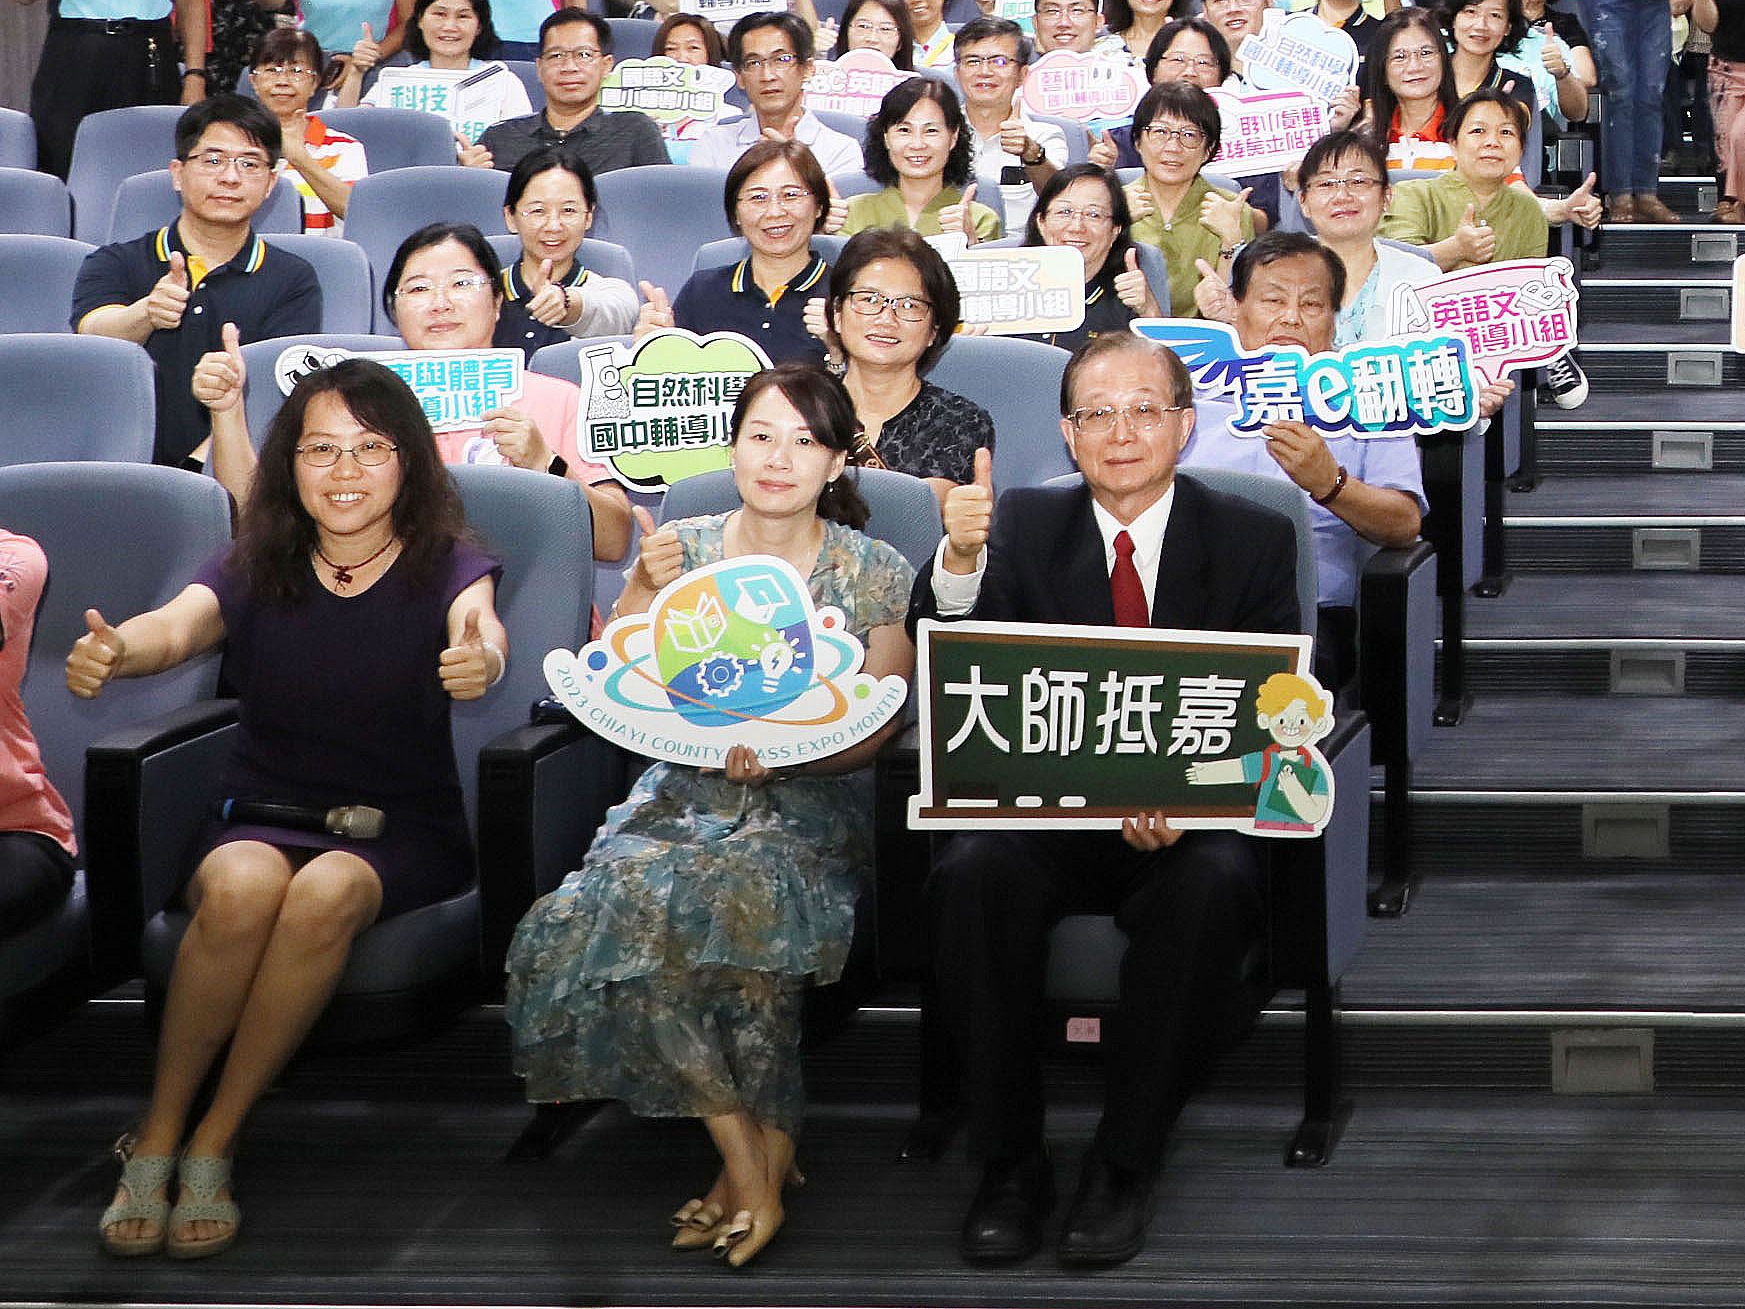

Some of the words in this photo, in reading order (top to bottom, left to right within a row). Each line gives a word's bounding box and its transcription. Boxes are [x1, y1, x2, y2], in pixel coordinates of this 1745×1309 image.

[1242, 40, 1343, 100] 國小輔導小組
[1276, 37, 1347, 76] 自然科學
[390, 84, 448, 112] 科技
[1041, 70, 1086, 92] 藝術
[1239, 106, 1322, 136] 輔導小組
[1431, 291, 1520, 329] 英語文
[1239, 345, 1467, 428] 嘉e翻轉
[557, 666, 588, 710] 2023
[589, 706, 647, 744] CHIAYI
[650, 734, 723, 762] COUNTY
[797, 731, 845, 756] EXPO
[849, 684, 900, 738] MONTH
[944, 665, 1246, 757] 大師抵嘉
